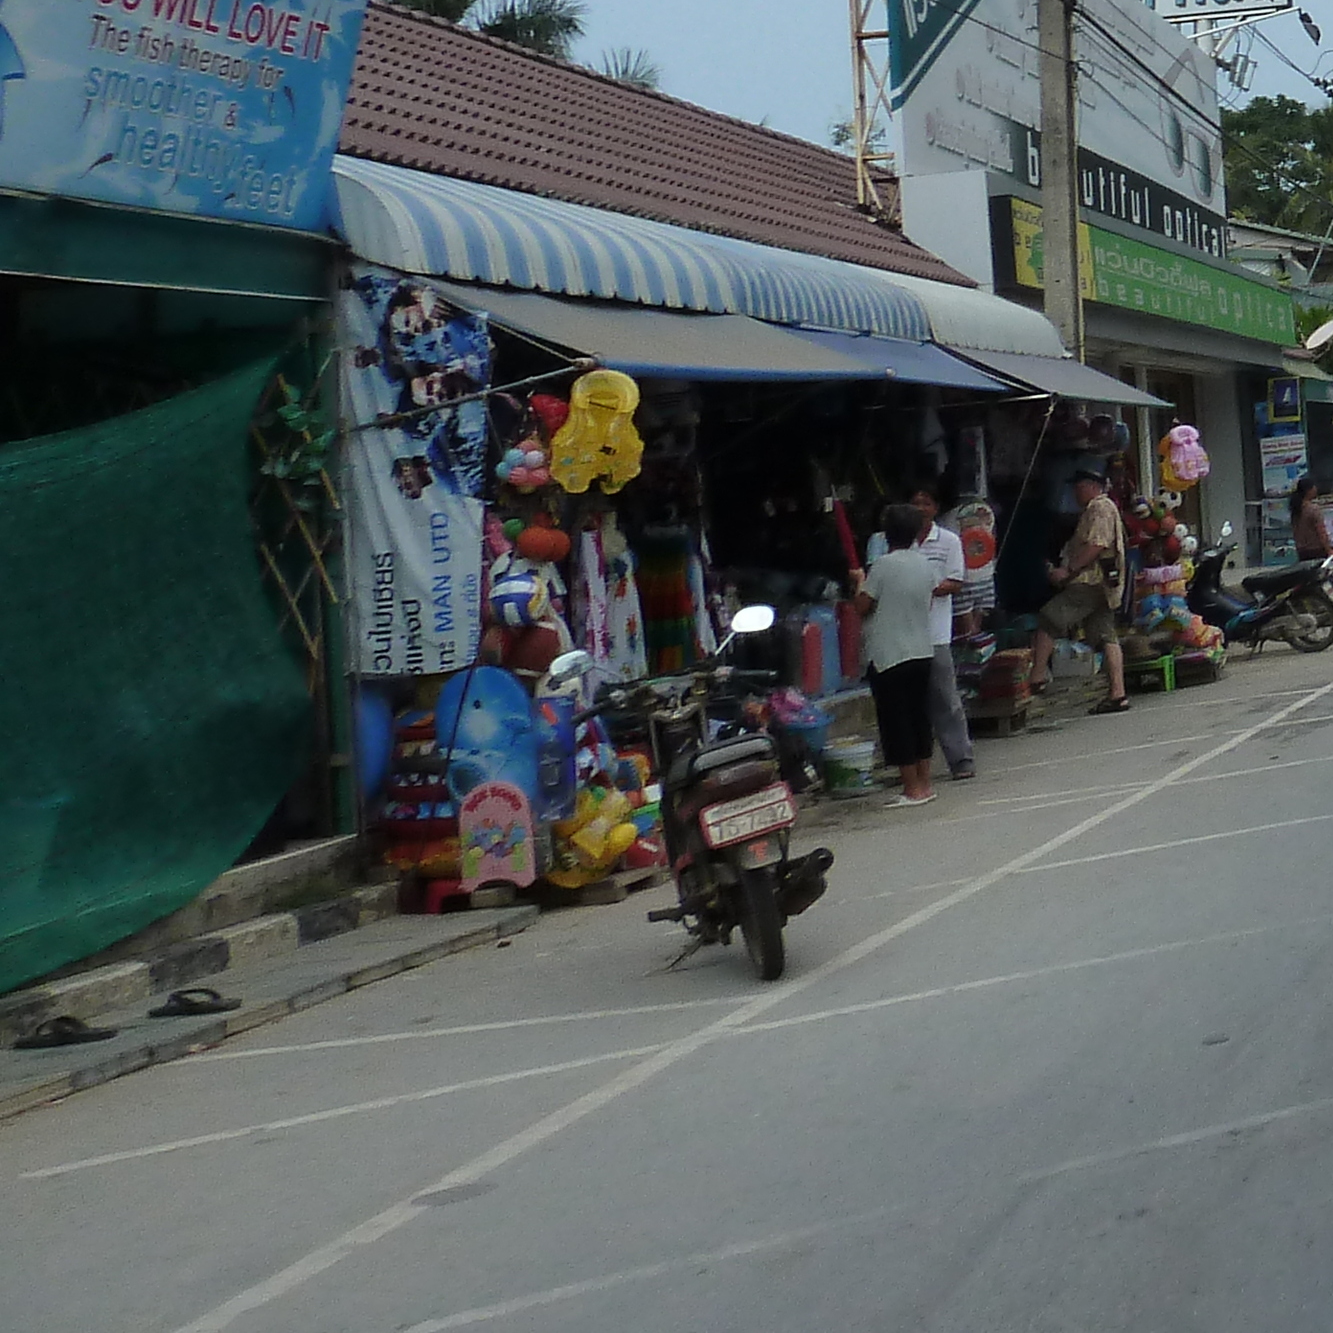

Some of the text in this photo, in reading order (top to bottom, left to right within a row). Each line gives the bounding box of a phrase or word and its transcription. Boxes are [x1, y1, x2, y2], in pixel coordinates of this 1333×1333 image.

[89, 14, 284, 91] The fish therapy for
[302, 20, 330, 62] IT
[85, 66, 239, 130] smoother &
[113, 123, 298, 216] healthy feet
[1027, 131, 1150, 228] butiful
[1163, 205, 1227, 259] optical
[429, 511, 452, 564] UTD
[431, 574, 455, 633] MAN
